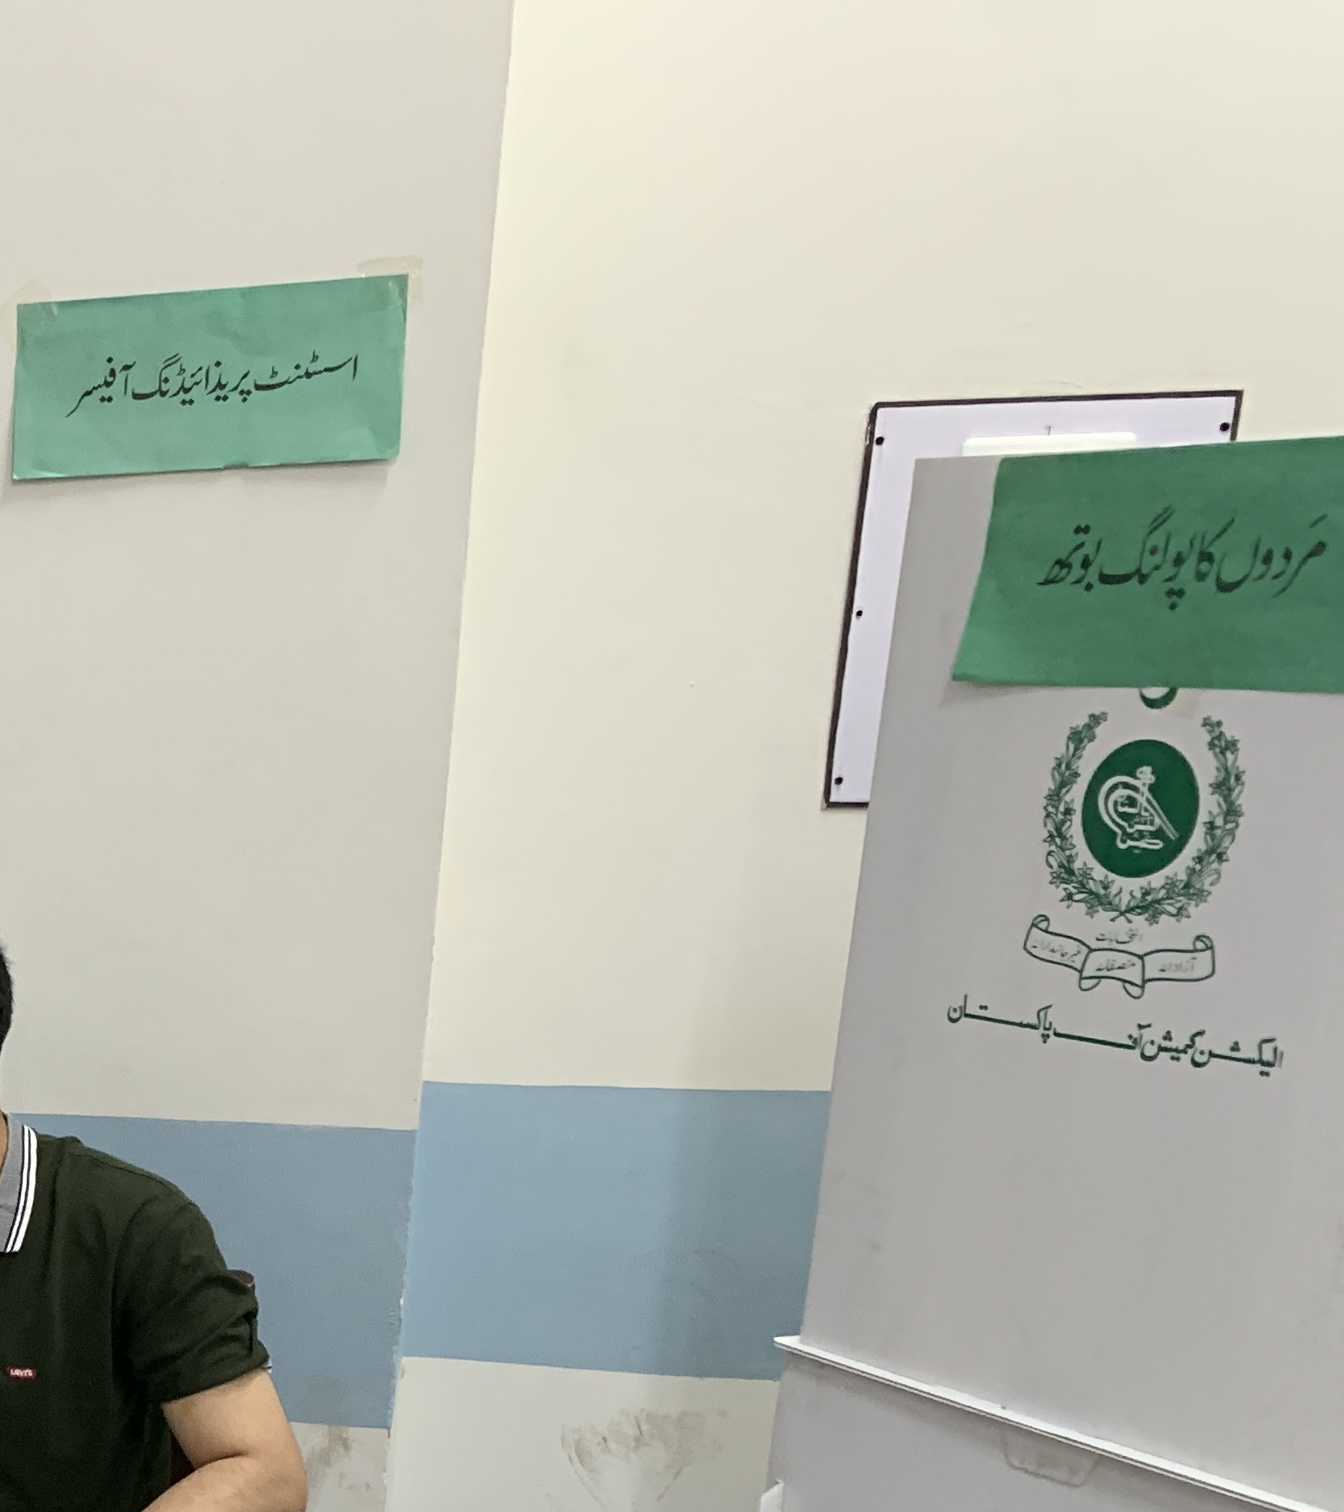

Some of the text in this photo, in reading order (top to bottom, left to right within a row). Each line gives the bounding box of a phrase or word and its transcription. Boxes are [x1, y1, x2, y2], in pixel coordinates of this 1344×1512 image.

[64, 356, 137, 419] آفیسر
[1036, 522, 1104, 594] بوتھ
[1097, 504, 1197, 612] پولنگ
[1194, 516, 1236, 584] کا
[947, 993, 1054, 1045] پاکستان
[1139, 1028, 1206, 1063] کمیشن
[1191, 1037, 1284, 1078] الیکشن
